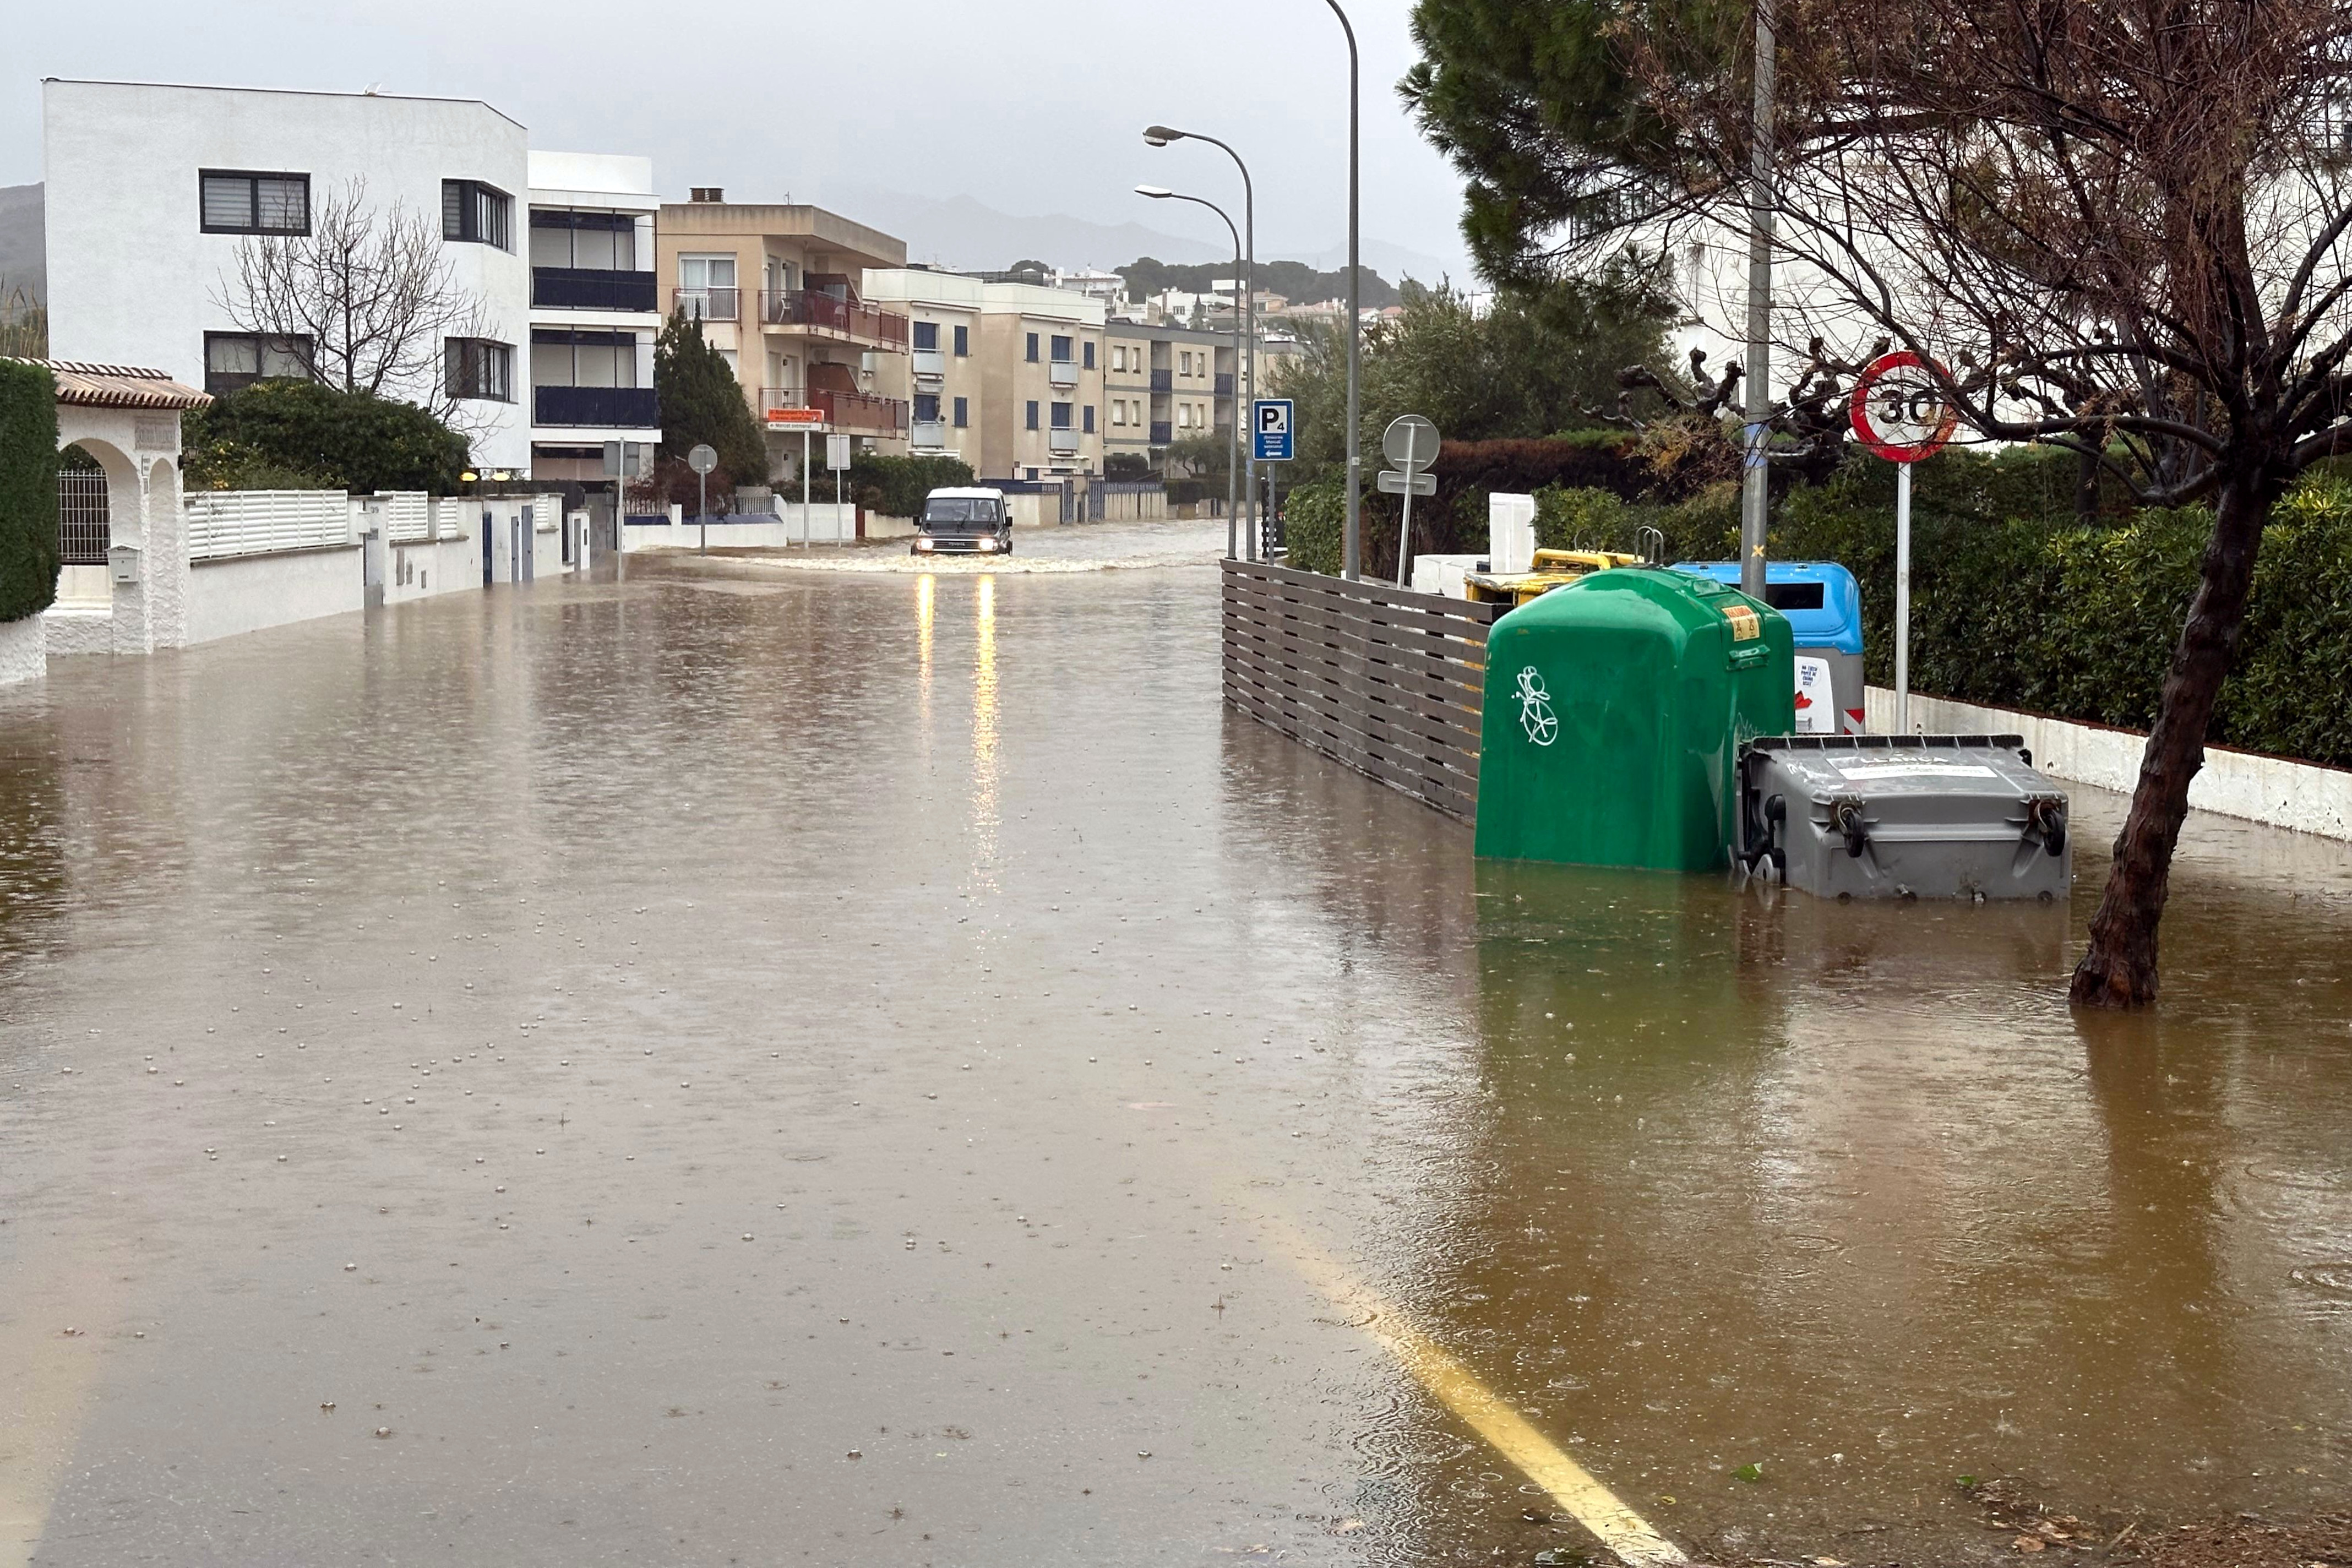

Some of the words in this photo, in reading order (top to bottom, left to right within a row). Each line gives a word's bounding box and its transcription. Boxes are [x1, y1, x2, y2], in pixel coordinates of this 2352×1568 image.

[1262, 409, 1279, 431] P
[1277, 422, 1284, 431] 4
[1879, 389, 1936, 424] 30
